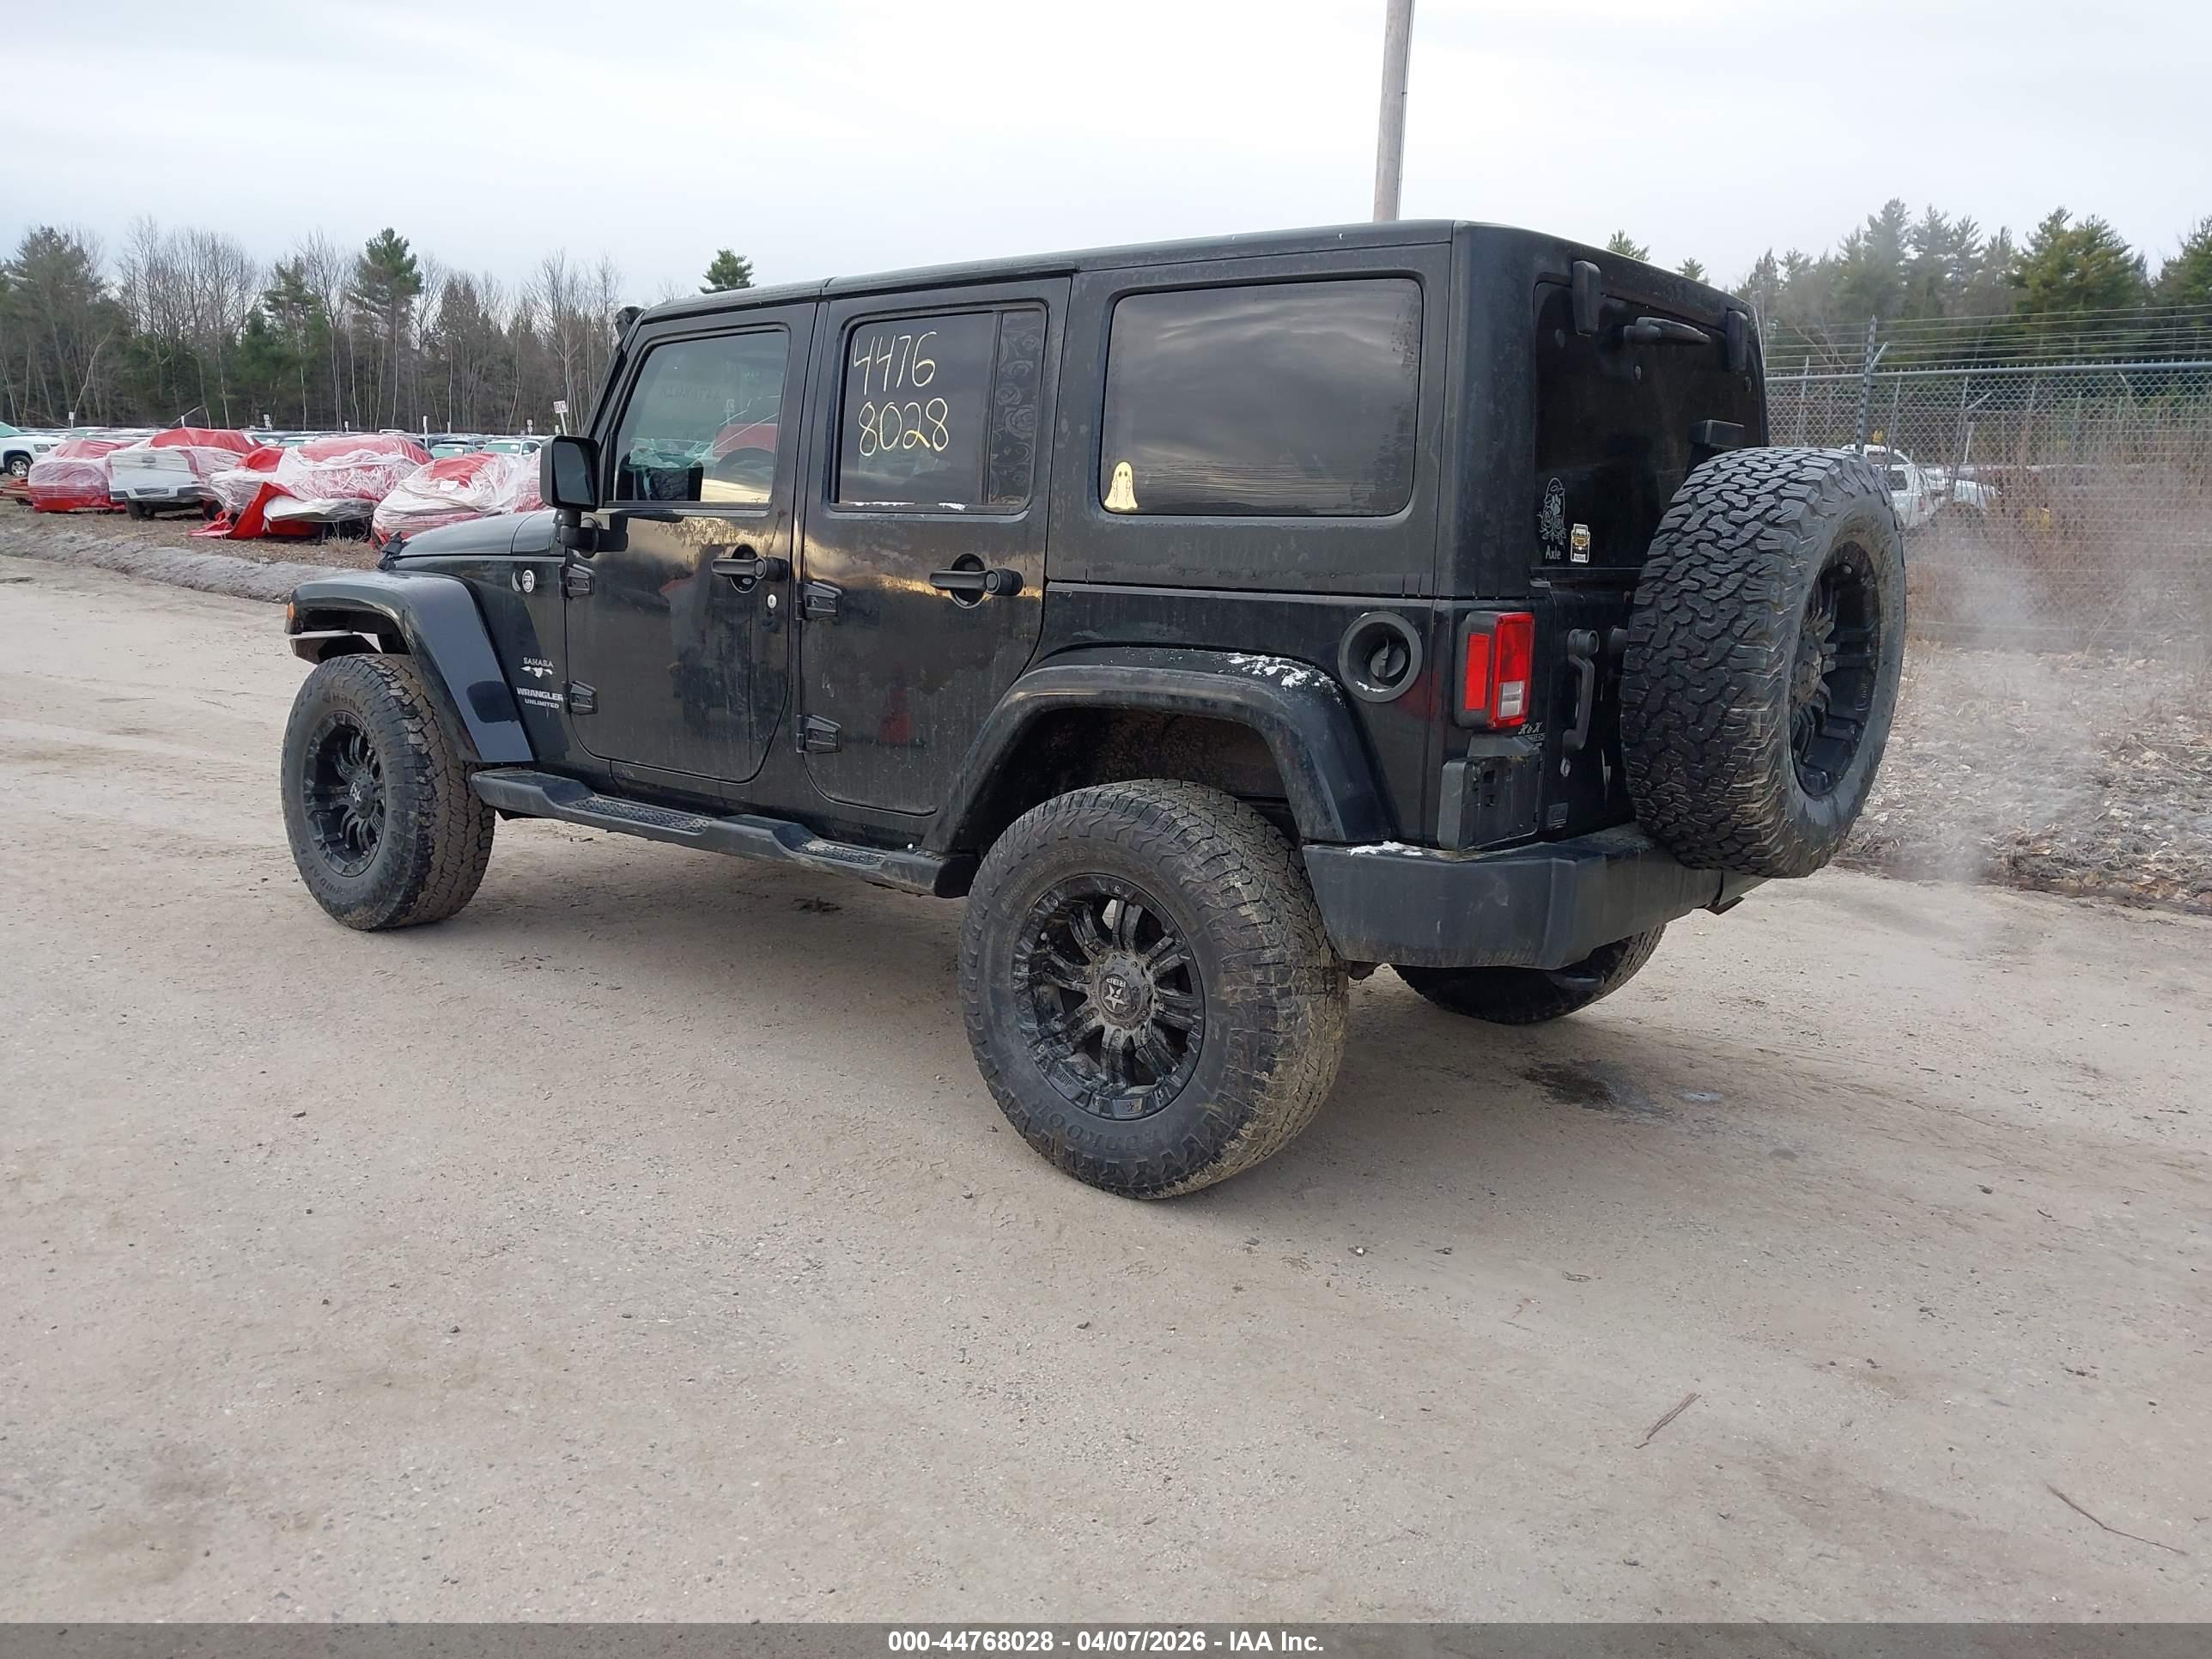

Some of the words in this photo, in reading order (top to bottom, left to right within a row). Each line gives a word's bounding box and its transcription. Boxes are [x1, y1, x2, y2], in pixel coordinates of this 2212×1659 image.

[854, 331, 938, 396] 4476
[859, 398, 949, 456] 8028
[523, 657, 554, 668] SAHARA
[516, 687, 563, 702] WRANGLER
[524, 698, 559, 708] UNLIMITED
